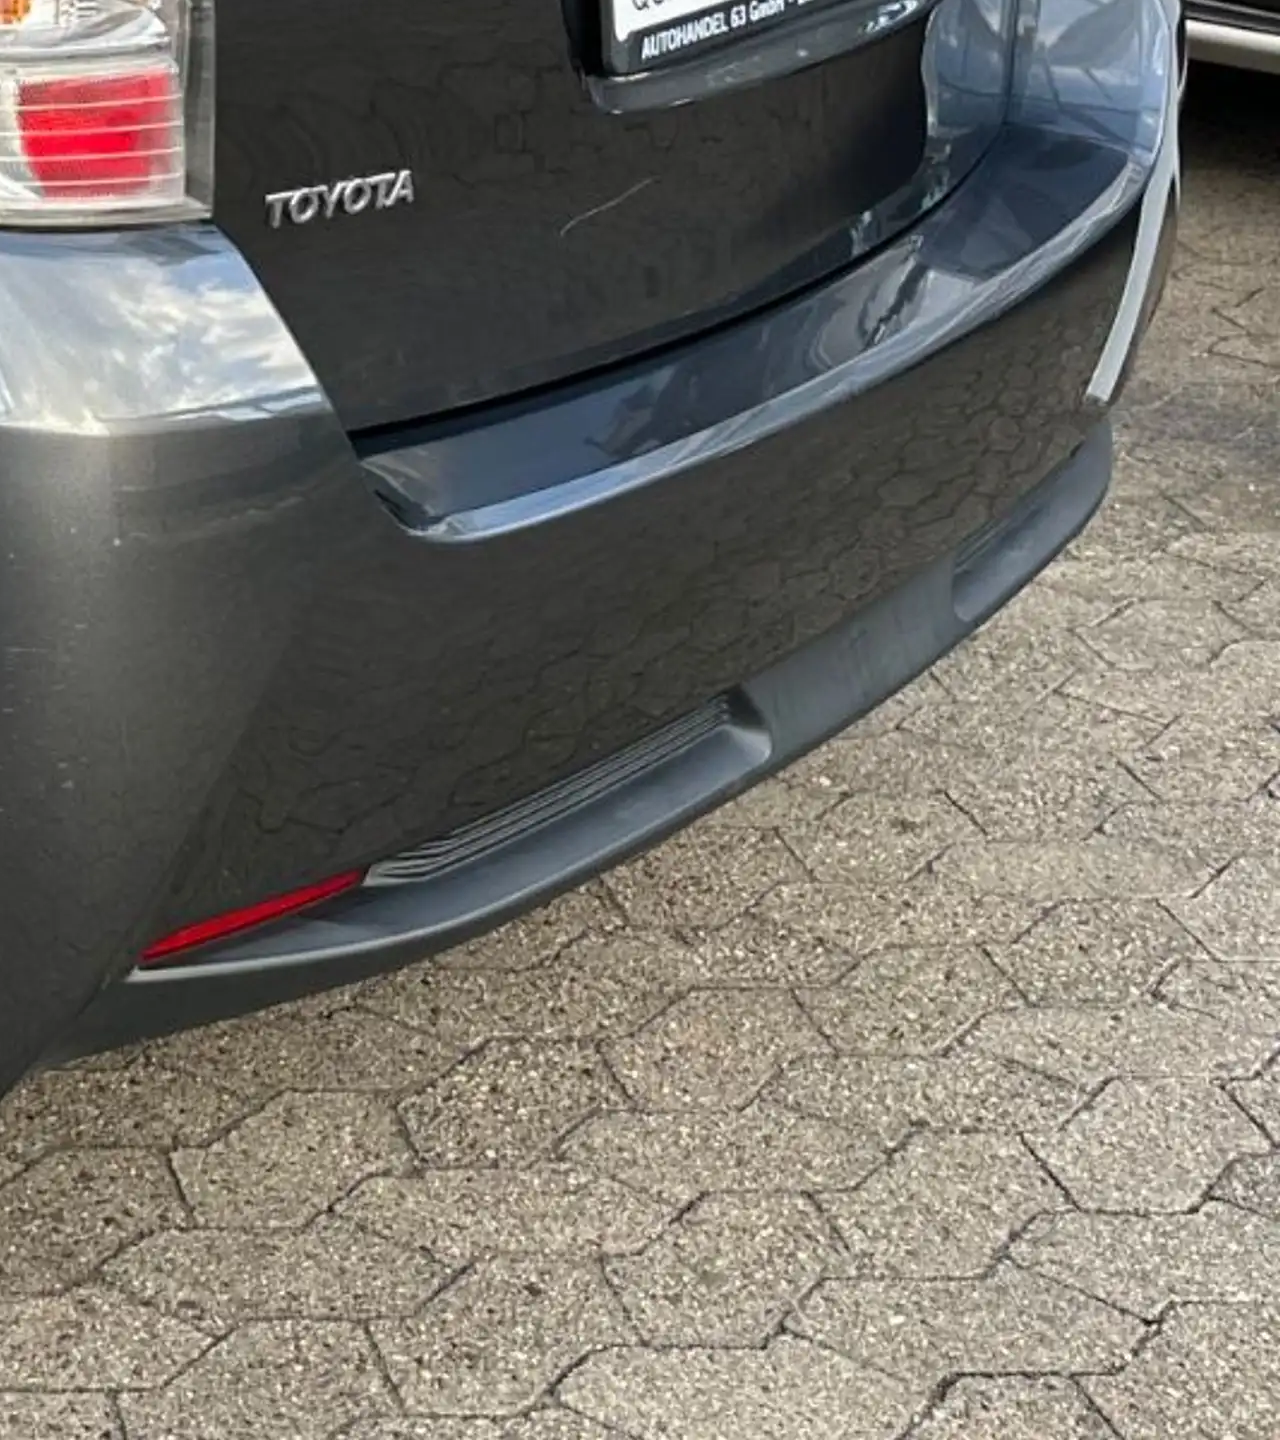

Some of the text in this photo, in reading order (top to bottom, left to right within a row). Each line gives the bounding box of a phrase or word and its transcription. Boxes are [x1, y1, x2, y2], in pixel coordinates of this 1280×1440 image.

[641, 12, 729, 60] AUTOHANDEL
[730, 3, 746, 29] 63
[265, 169, 414, 228] TOYOTA
